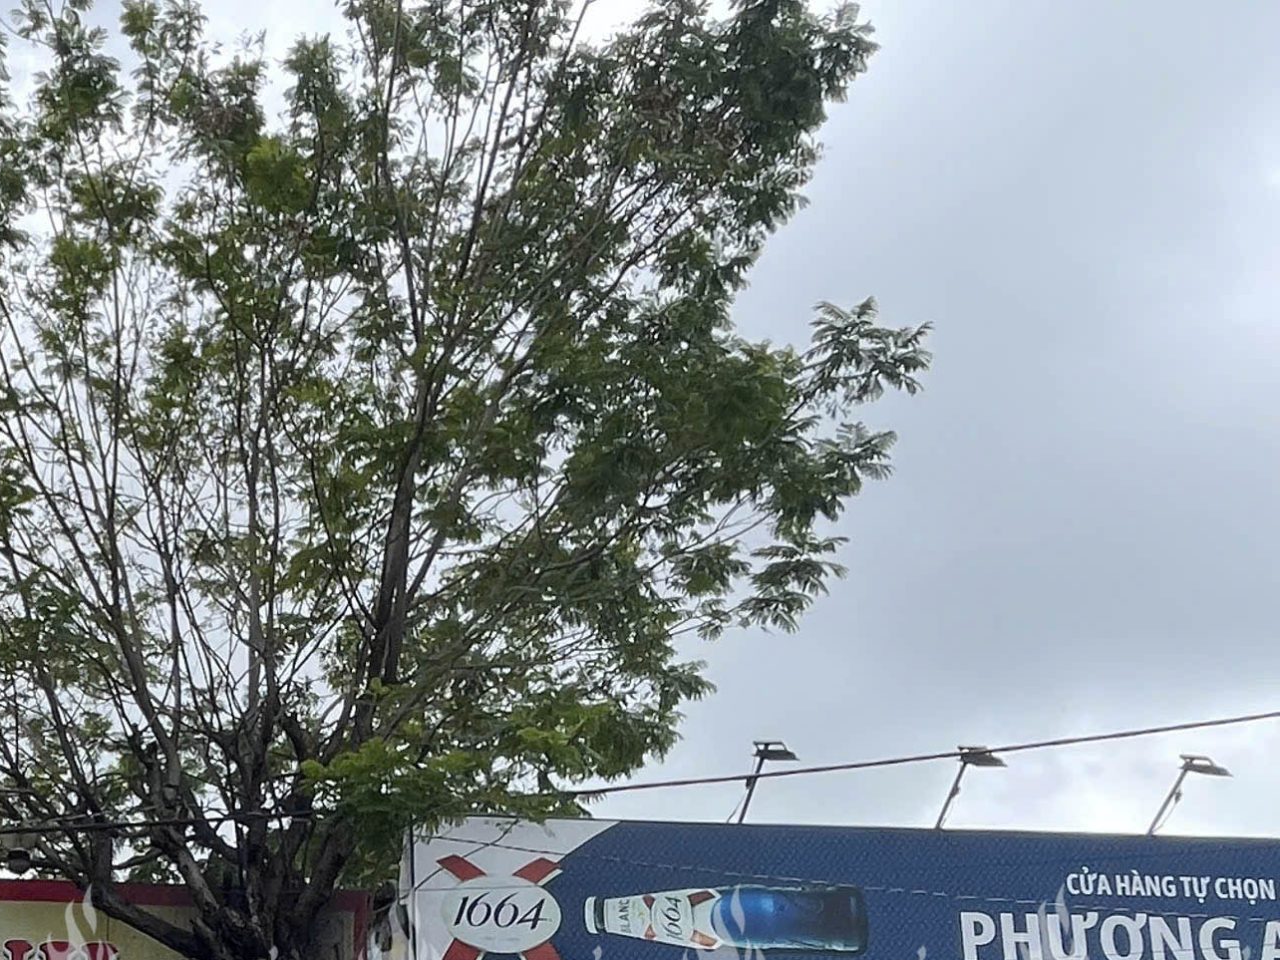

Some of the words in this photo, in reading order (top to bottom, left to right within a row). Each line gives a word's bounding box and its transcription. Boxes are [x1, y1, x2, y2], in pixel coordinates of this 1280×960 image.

[1066, 866, 1113, 896] CỬA
[1116, 869, 1177, 898] HÀNG
[1179, 876, 1211, 904] TỰ
[1215, 877, 1276, 905] CHỌN
[453, 892, 548, 930] 1664
